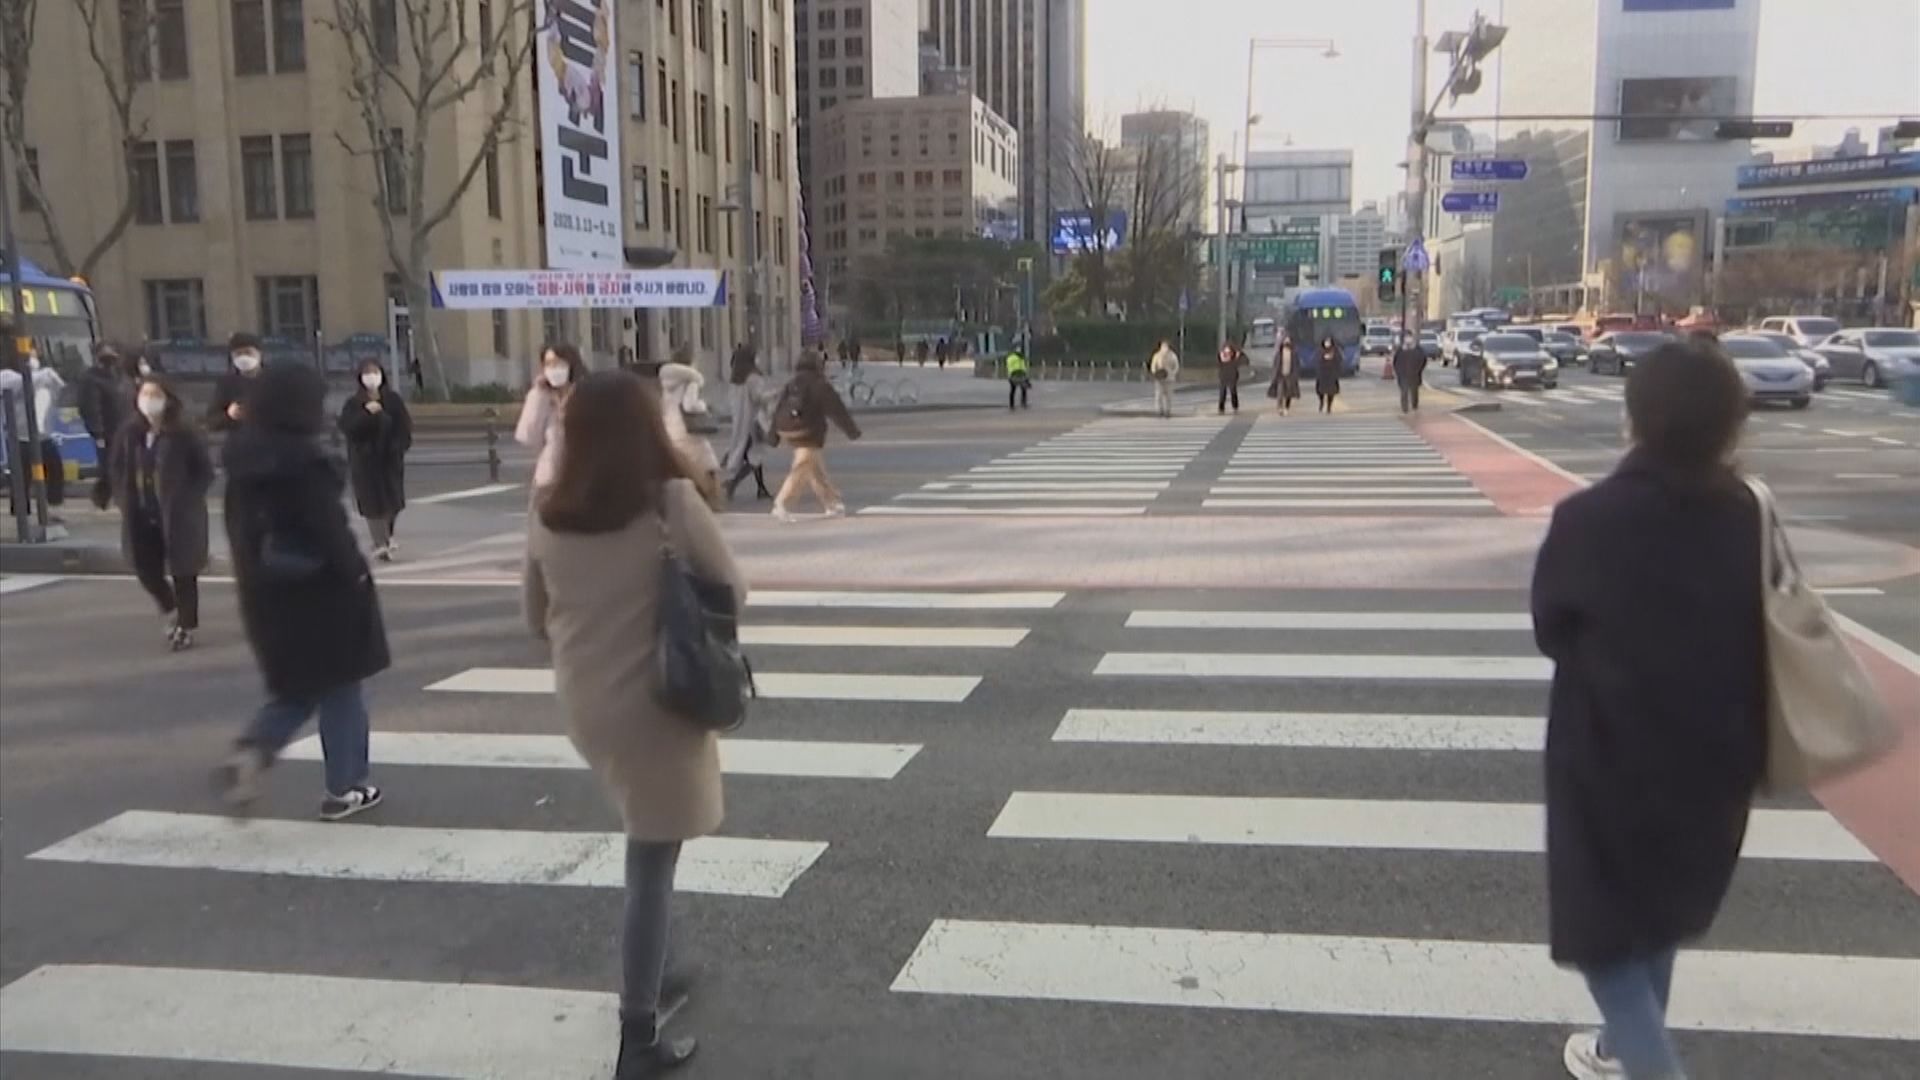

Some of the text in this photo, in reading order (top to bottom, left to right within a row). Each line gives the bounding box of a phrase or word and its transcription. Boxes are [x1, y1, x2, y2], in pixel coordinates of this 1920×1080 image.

[448, 283, 479, 296] 사람이
[504, 283, 535, 296] 모이는
[634, 282, 663, 296] 주시기
